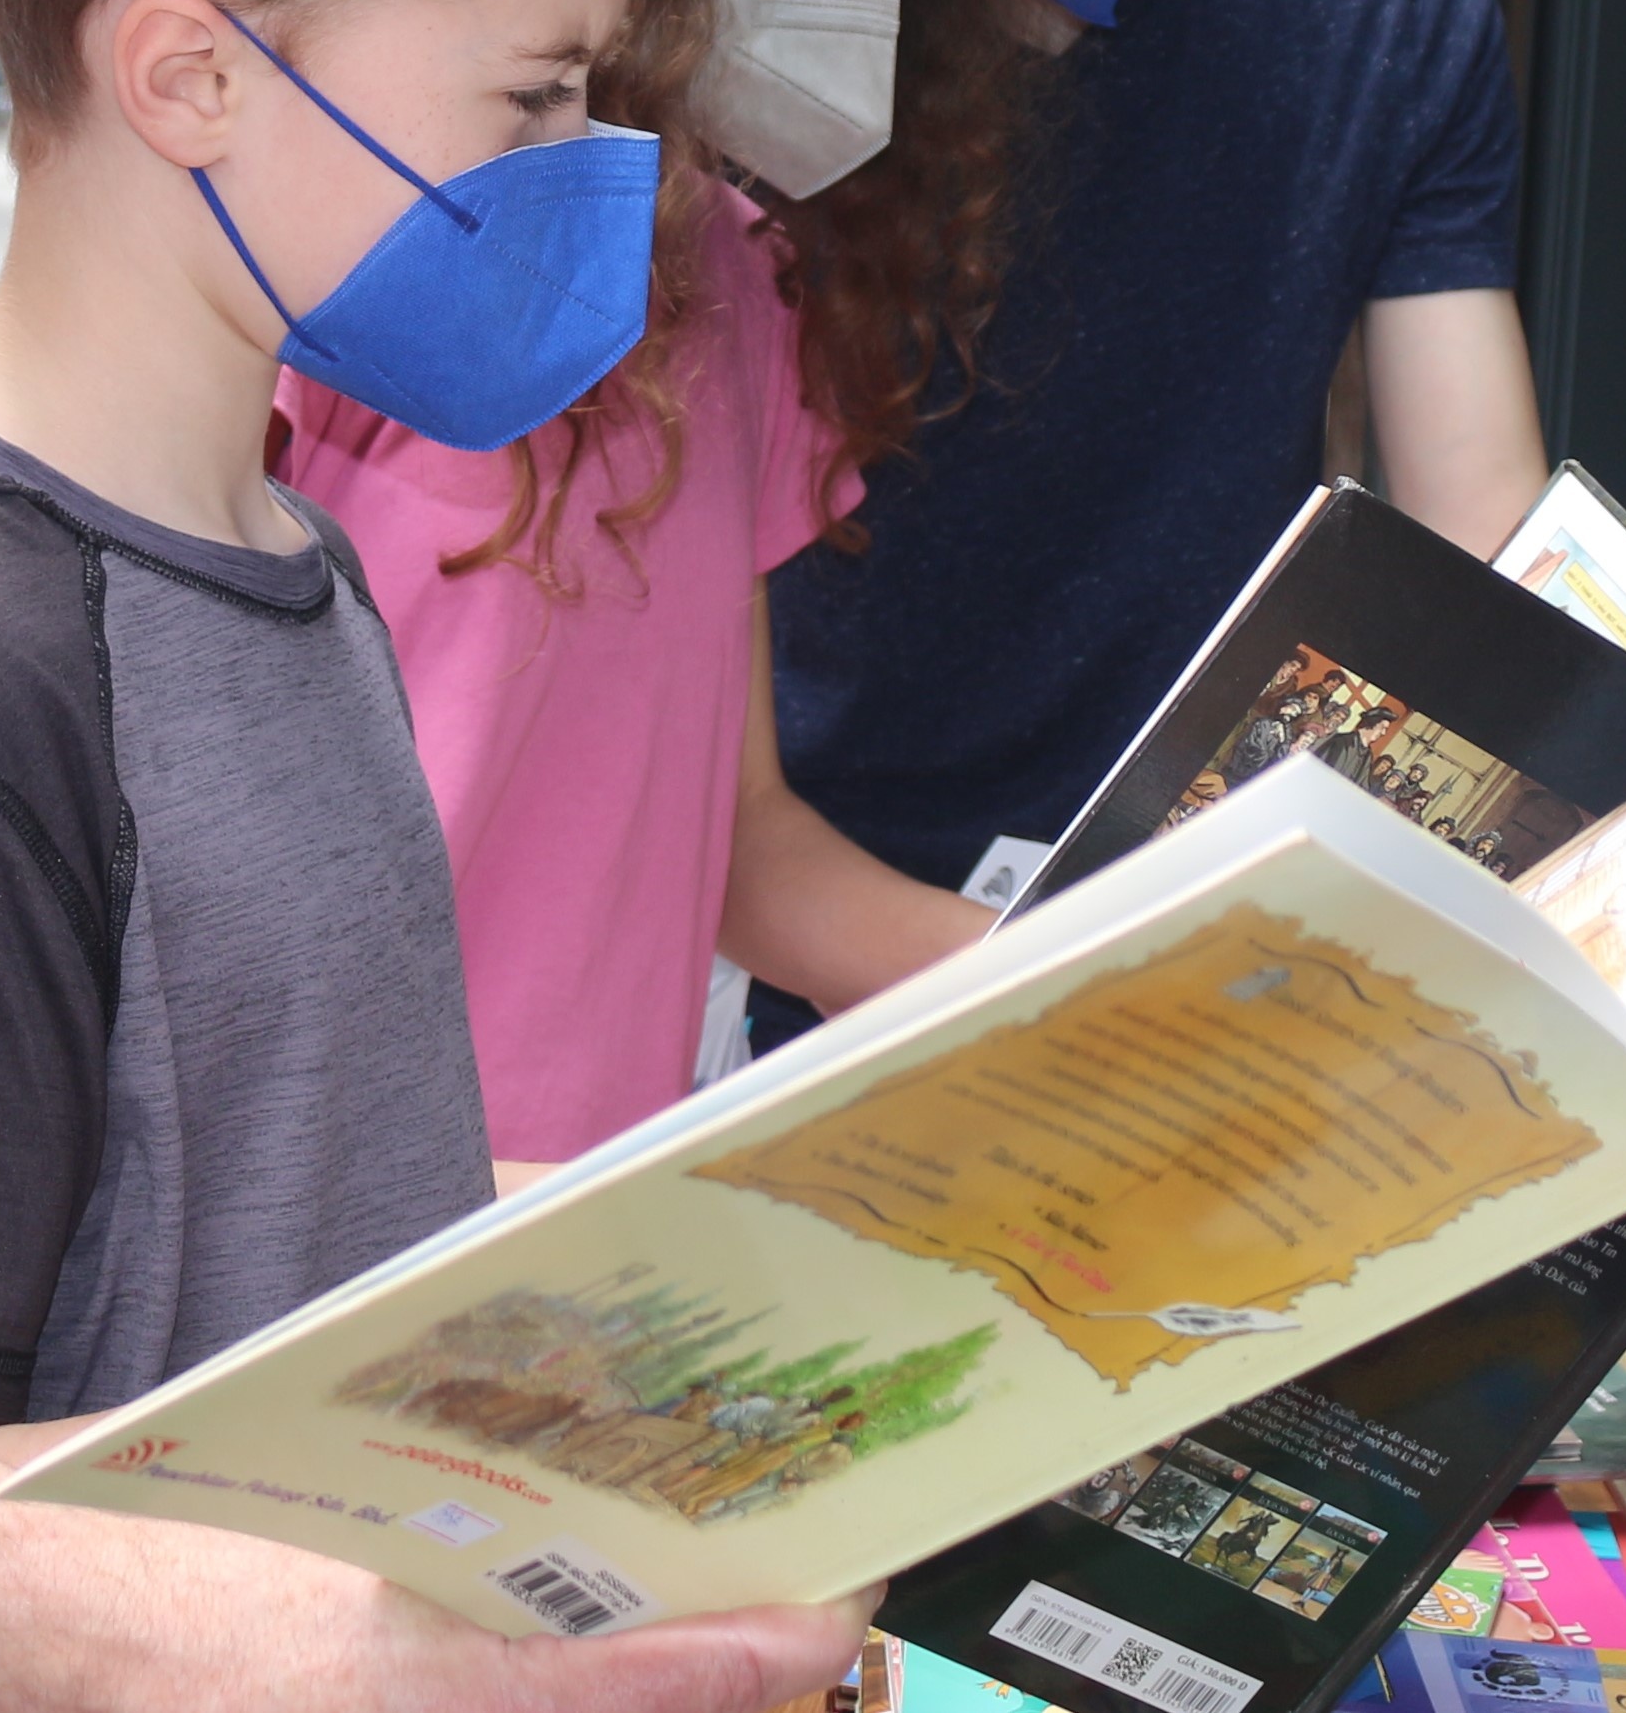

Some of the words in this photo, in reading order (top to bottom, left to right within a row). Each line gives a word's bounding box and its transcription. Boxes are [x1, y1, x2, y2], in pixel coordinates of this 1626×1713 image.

[1601, 1241, 1618, 1259] Tin
[1420, 1444, 1439, 1462] một
[1200, 1662, 1238, 1688] 130.000
